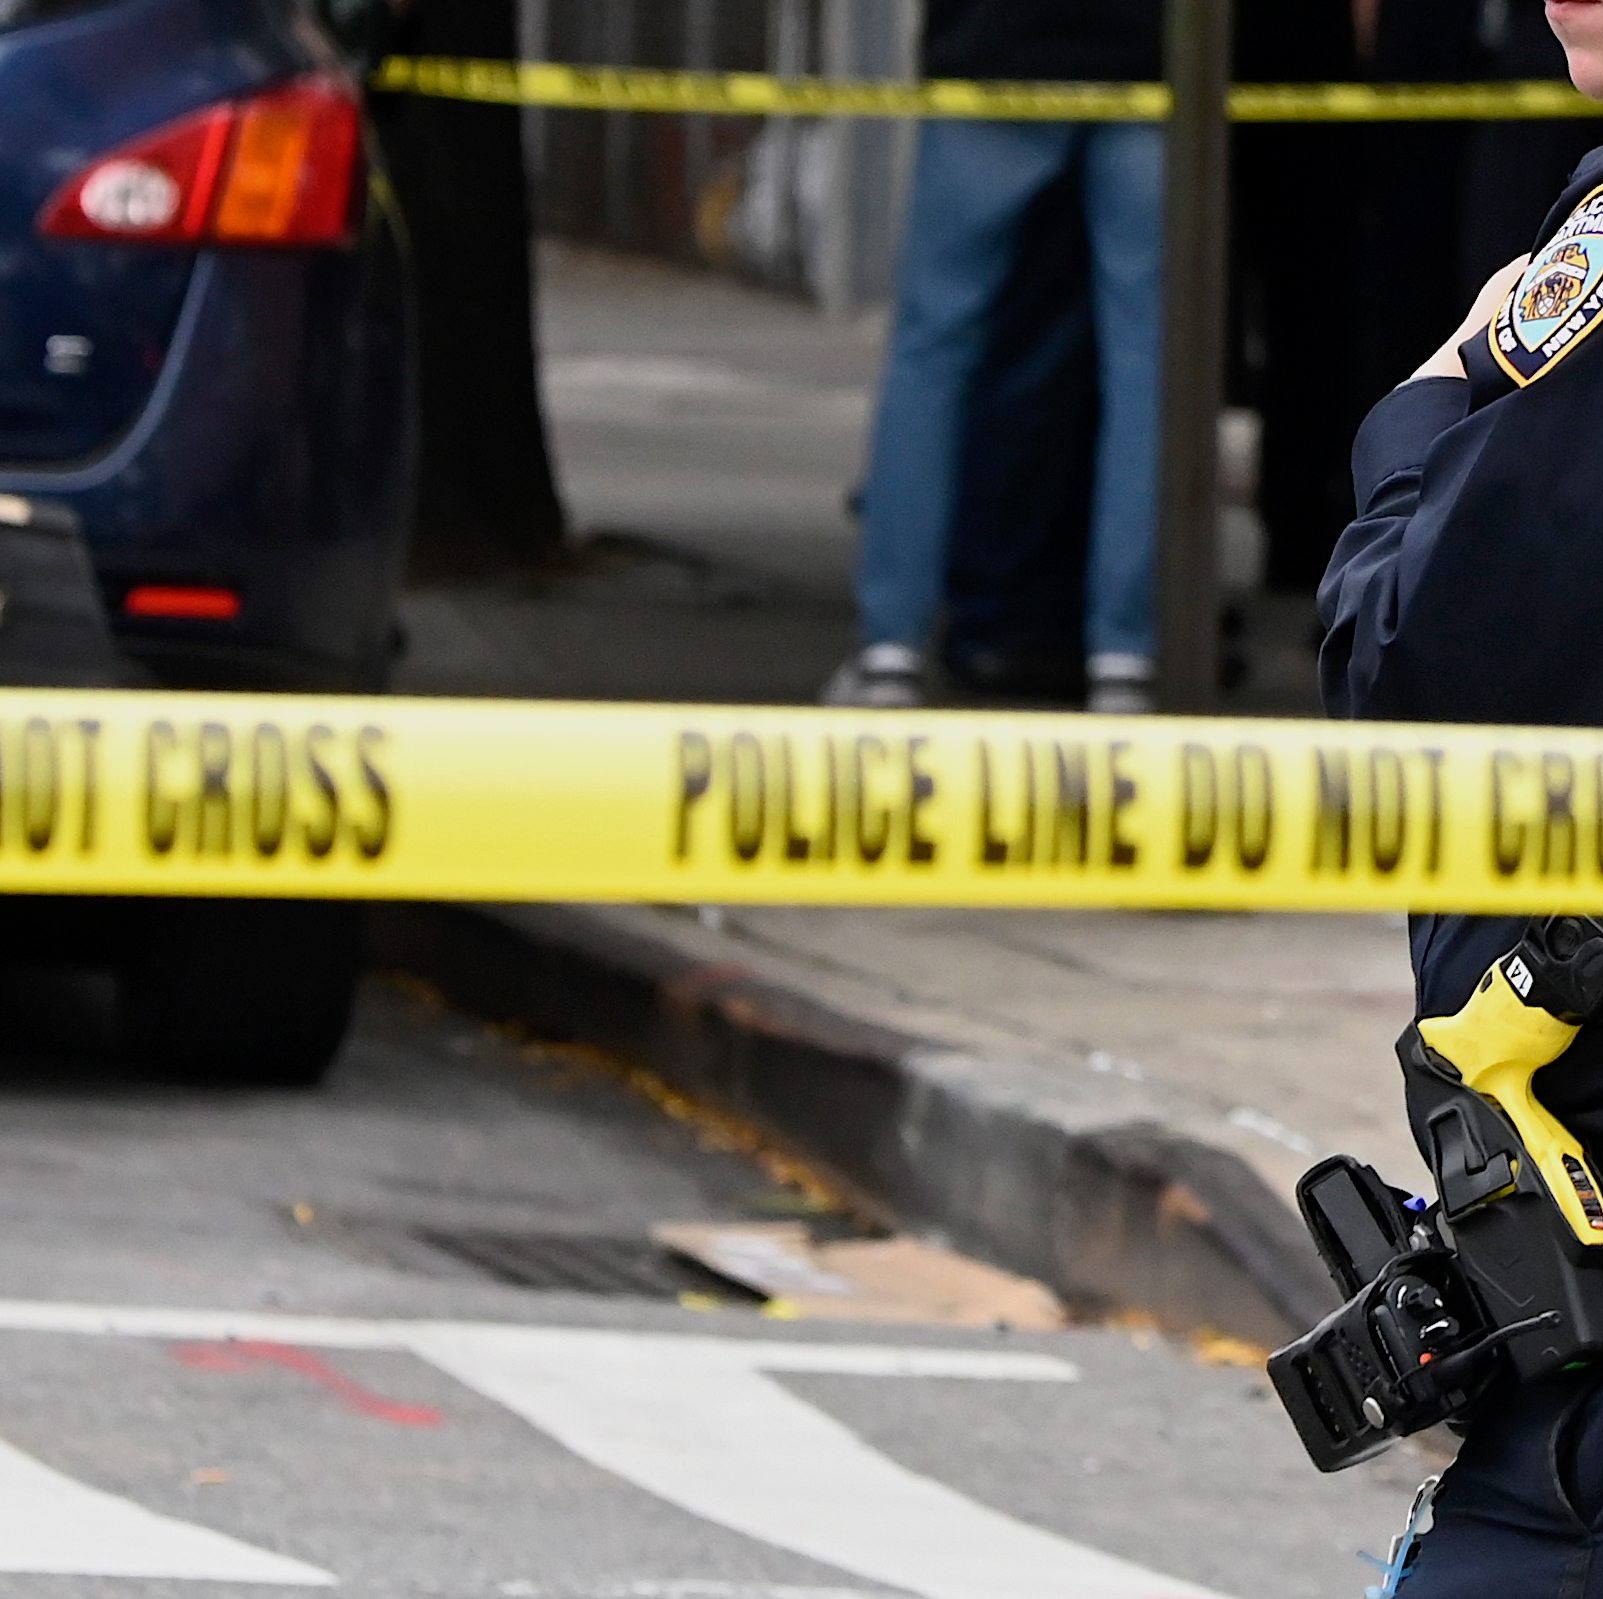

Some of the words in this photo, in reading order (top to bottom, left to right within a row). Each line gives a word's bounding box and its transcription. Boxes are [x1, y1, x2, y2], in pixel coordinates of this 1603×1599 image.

[1541, 310, 1587, 358] NEW
[0, 716, 101, 854] OT
[146, 719, 391, 859] CROSS
[674, 729, 938, 864] POLICE
[976, 735, 1140, 869] LINE
[1175, 740, 1275, 873] DO
[1307, 744, 1444, 877] NOT
